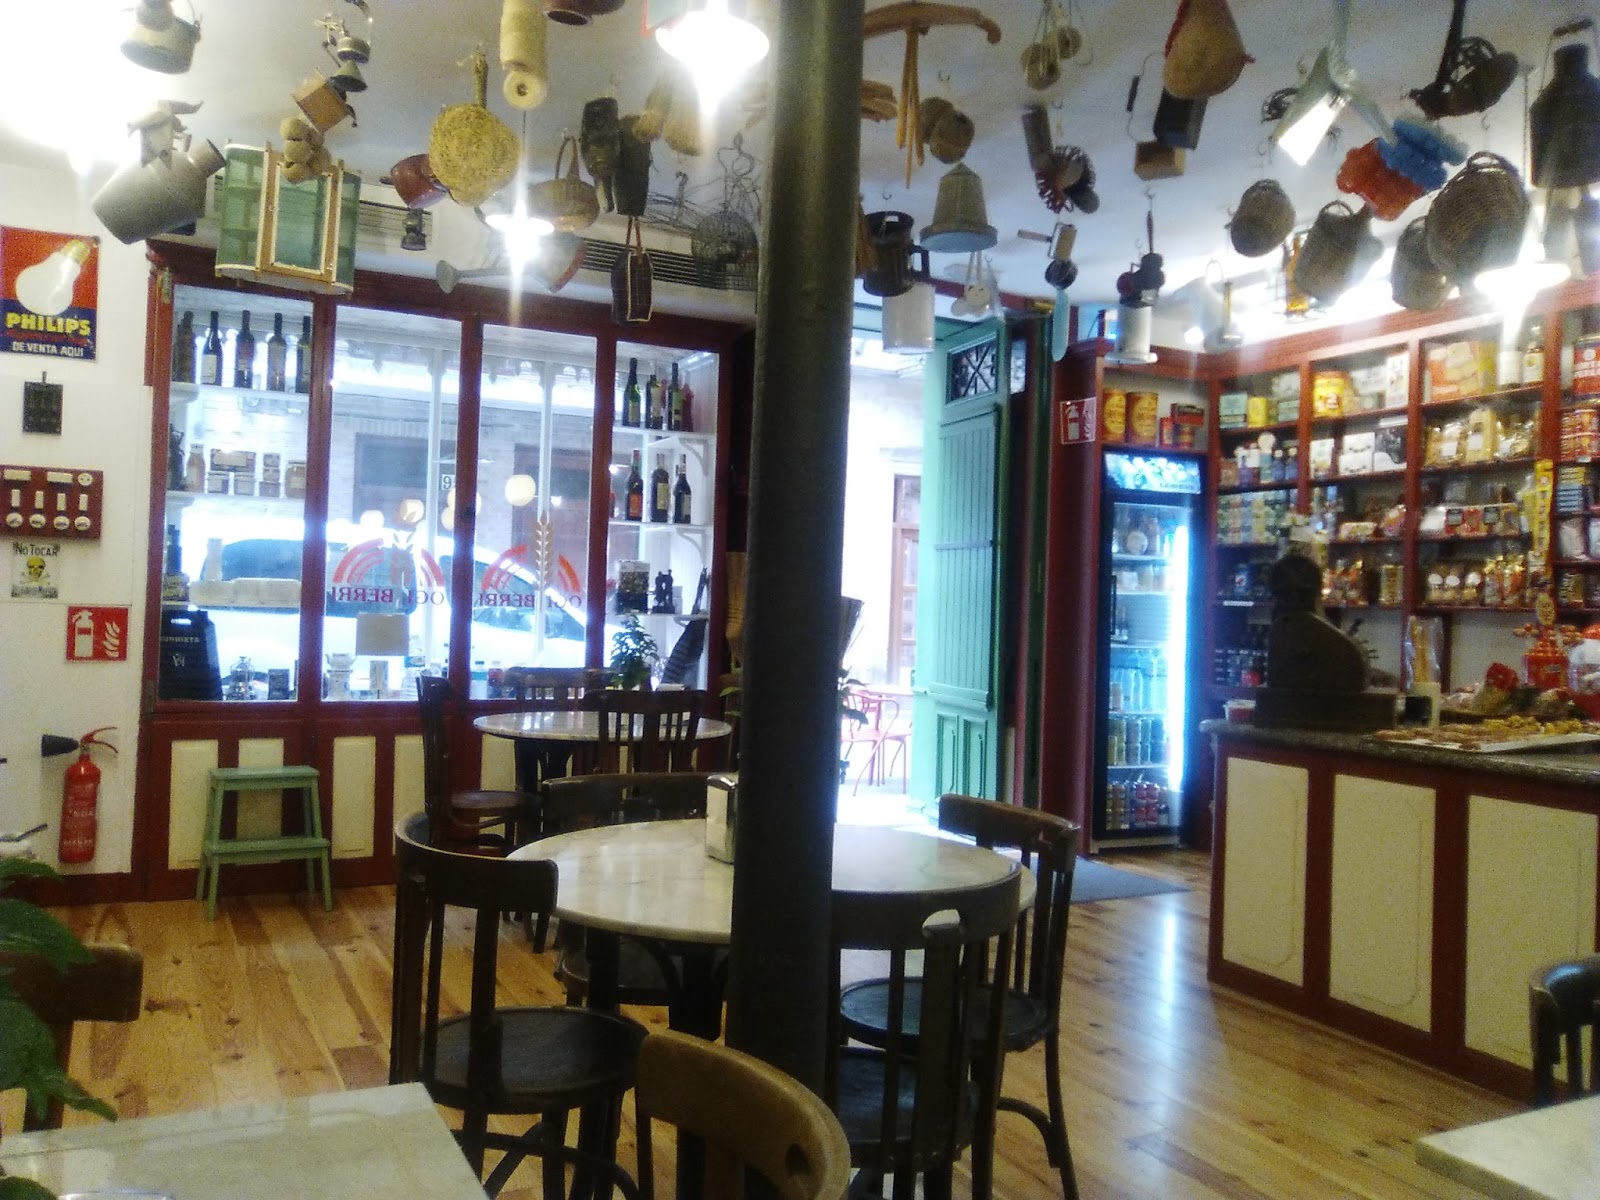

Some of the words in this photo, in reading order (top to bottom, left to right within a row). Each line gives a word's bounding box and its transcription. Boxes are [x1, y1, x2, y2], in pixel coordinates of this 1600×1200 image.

[6, 312, 91, 336] PHILIPS
[12, 341, 25, 352] DE
[27, 343, 57, 354] VENTA
[60, 346, 84, 357] AQUI
